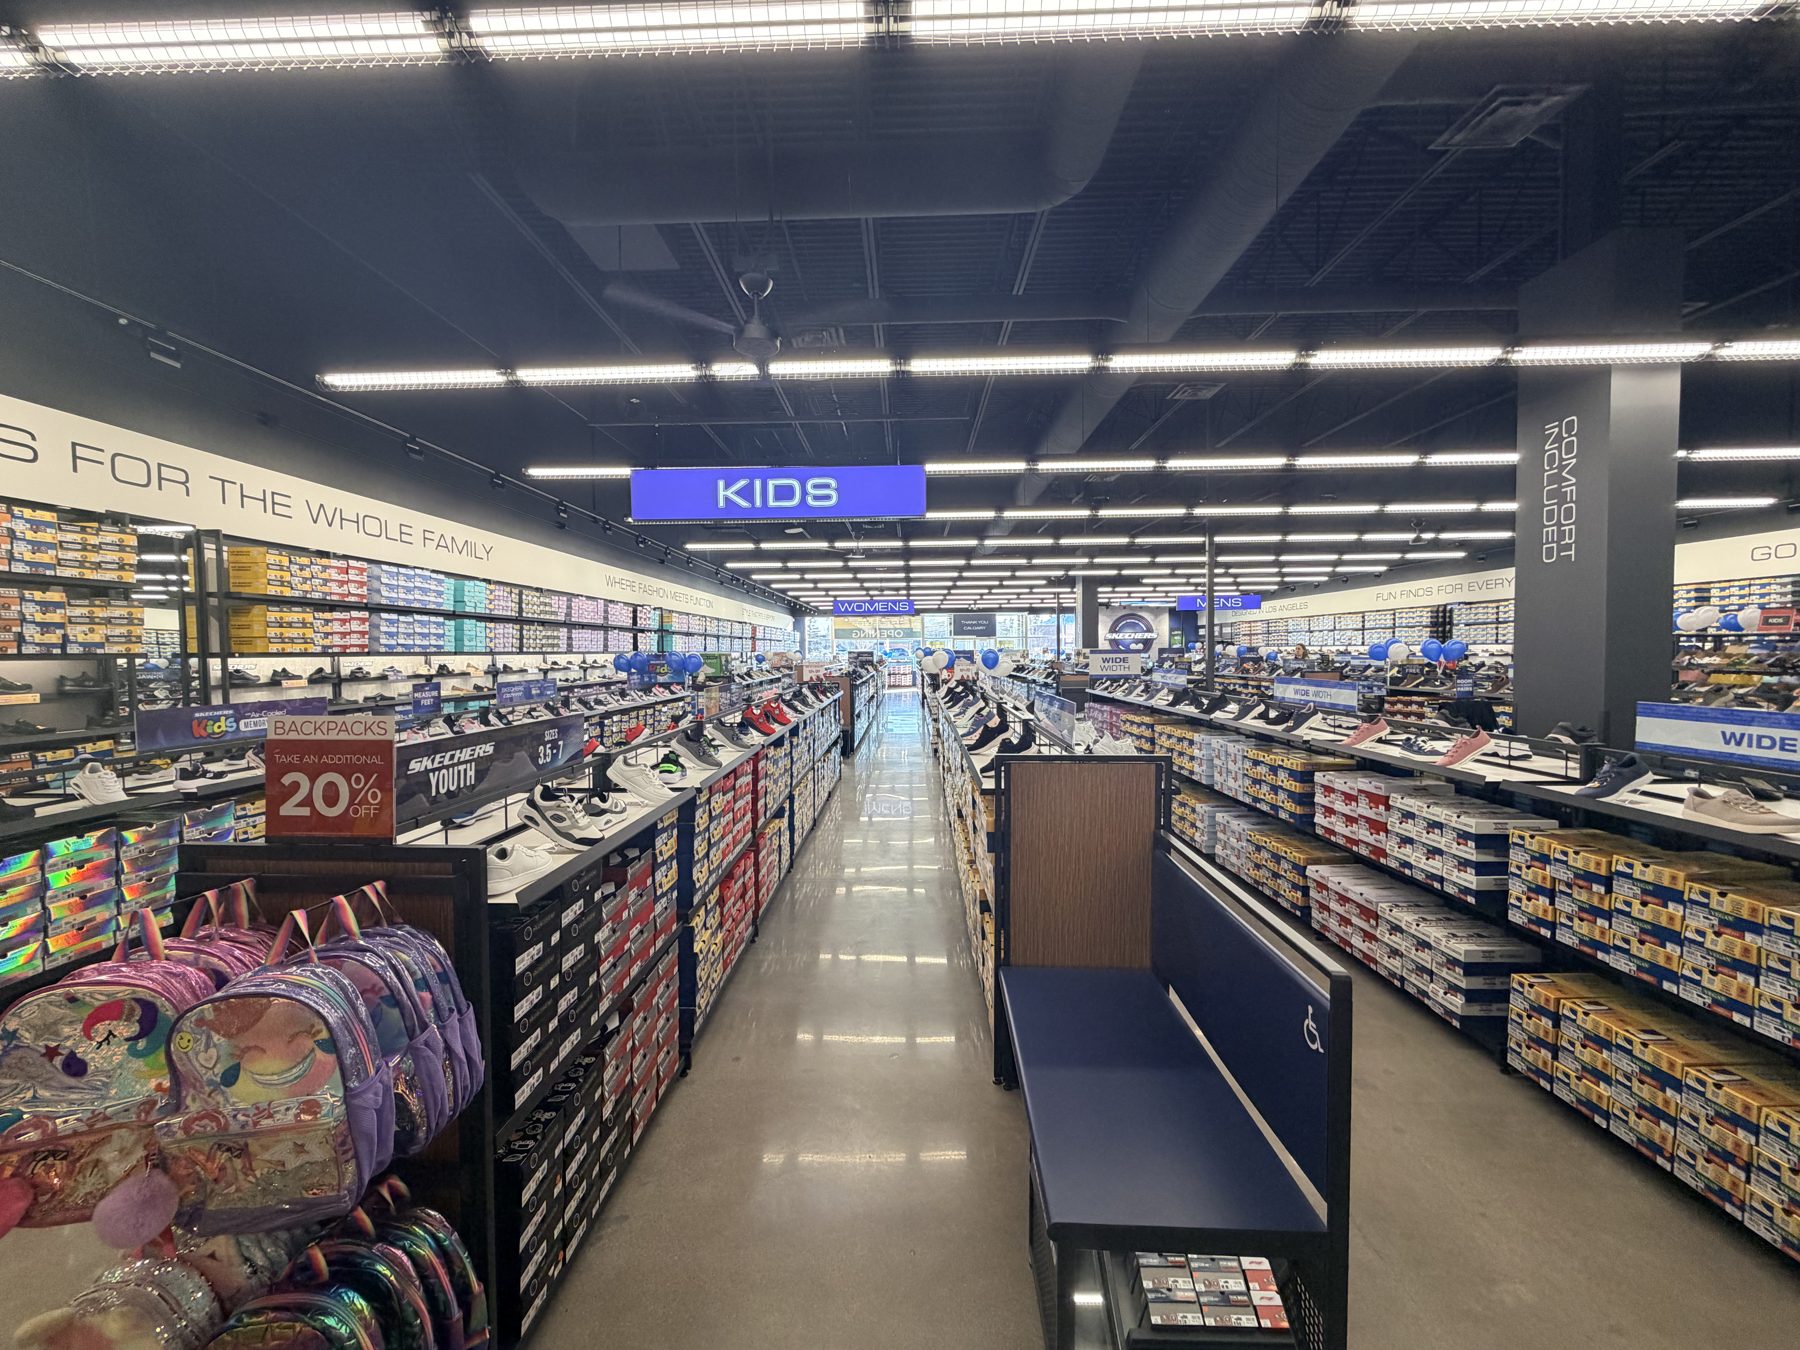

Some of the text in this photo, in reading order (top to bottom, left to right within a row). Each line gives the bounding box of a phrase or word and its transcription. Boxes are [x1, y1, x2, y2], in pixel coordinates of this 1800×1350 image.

[717, 477, 838, 508] KIDS
[1542, 421, 1559, 563] INCLUDED
[1560, 416, 1577, 561] COMFORT
[71, 441, 190, 497] FOR
[209, 475, 292, 519] THE
[305, 499, 413, 545] WHOLE
[422, 529, 494, 562] FAMILY
[605, 574, 636, 592] WHERE
[638, 582, 668, 600] FASHION
[670, 590, 689, 604] MEETS
[1376, 577, 1515, 602] FUN FINDS FOR EVERY
[838, 602, 909, 612] WOMENS
[1265, 605, 1277, 613] LOS
[1278, 601, 1308, 612] ANGELES
[1104, 632, 1159, 641] SKECHERS
[1101, 656, 1129, 664] WIDE
[414, 690, 438, 699] MEASURE
[1293, 688, 1332, 700] WIDE WIDTH
[194, 709, 234, 718] SKECHERS
[192, 716, 237, 739] Kids
[243, 719, 267, 729] MEMOR
[274, 720, 388, 736] BACKPACKS
[544, 728, 558, 741] SIZES
[1721, 731, 1798, 754] WIDE
[274, 754, 384, 765] TAKE AN ADDITIONAL
[407, 742, 496, 775] SKECHERS
[538, 744, 551, 765] 3.5
[558, 740, 564, 759] 7
[429, 762, 476, 797] YOUTH
[279, 772, 382, 818] 20%
[350, 805, 381, 818] OFF
